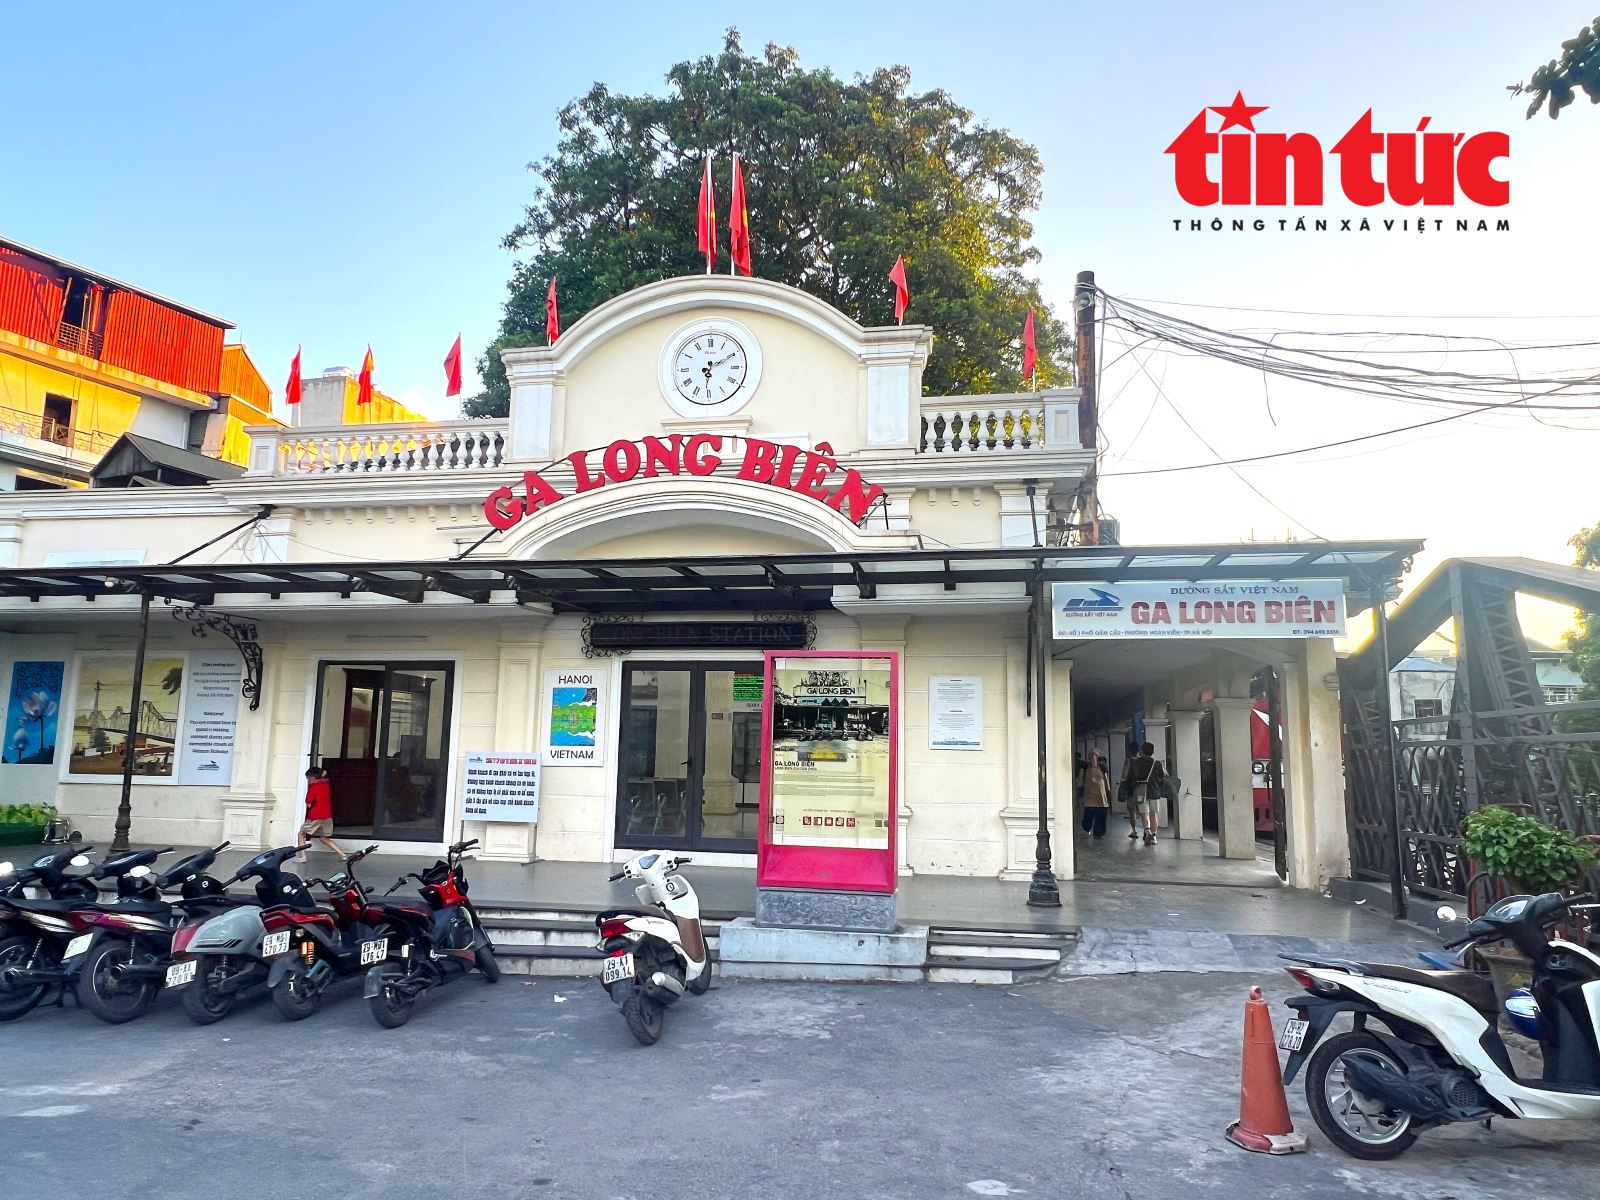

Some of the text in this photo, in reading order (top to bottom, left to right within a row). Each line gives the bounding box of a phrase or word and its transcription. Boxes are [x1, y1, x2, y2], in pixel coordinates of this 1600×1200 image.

[483, 433, 884, 531] GA LONG BIÊN
[1170, 585, 1298, 595] ĐƯỜNG SẮT VIỆT NAM
[1131, 595, 1336, 624] GA LONG BIÊN
[709, 625, 792, 642] STATION
[558, 675, 593, 684] HANOI
[818, 687, 839, 695] LONG
[550, 749, 594, 759] VIETNAM
